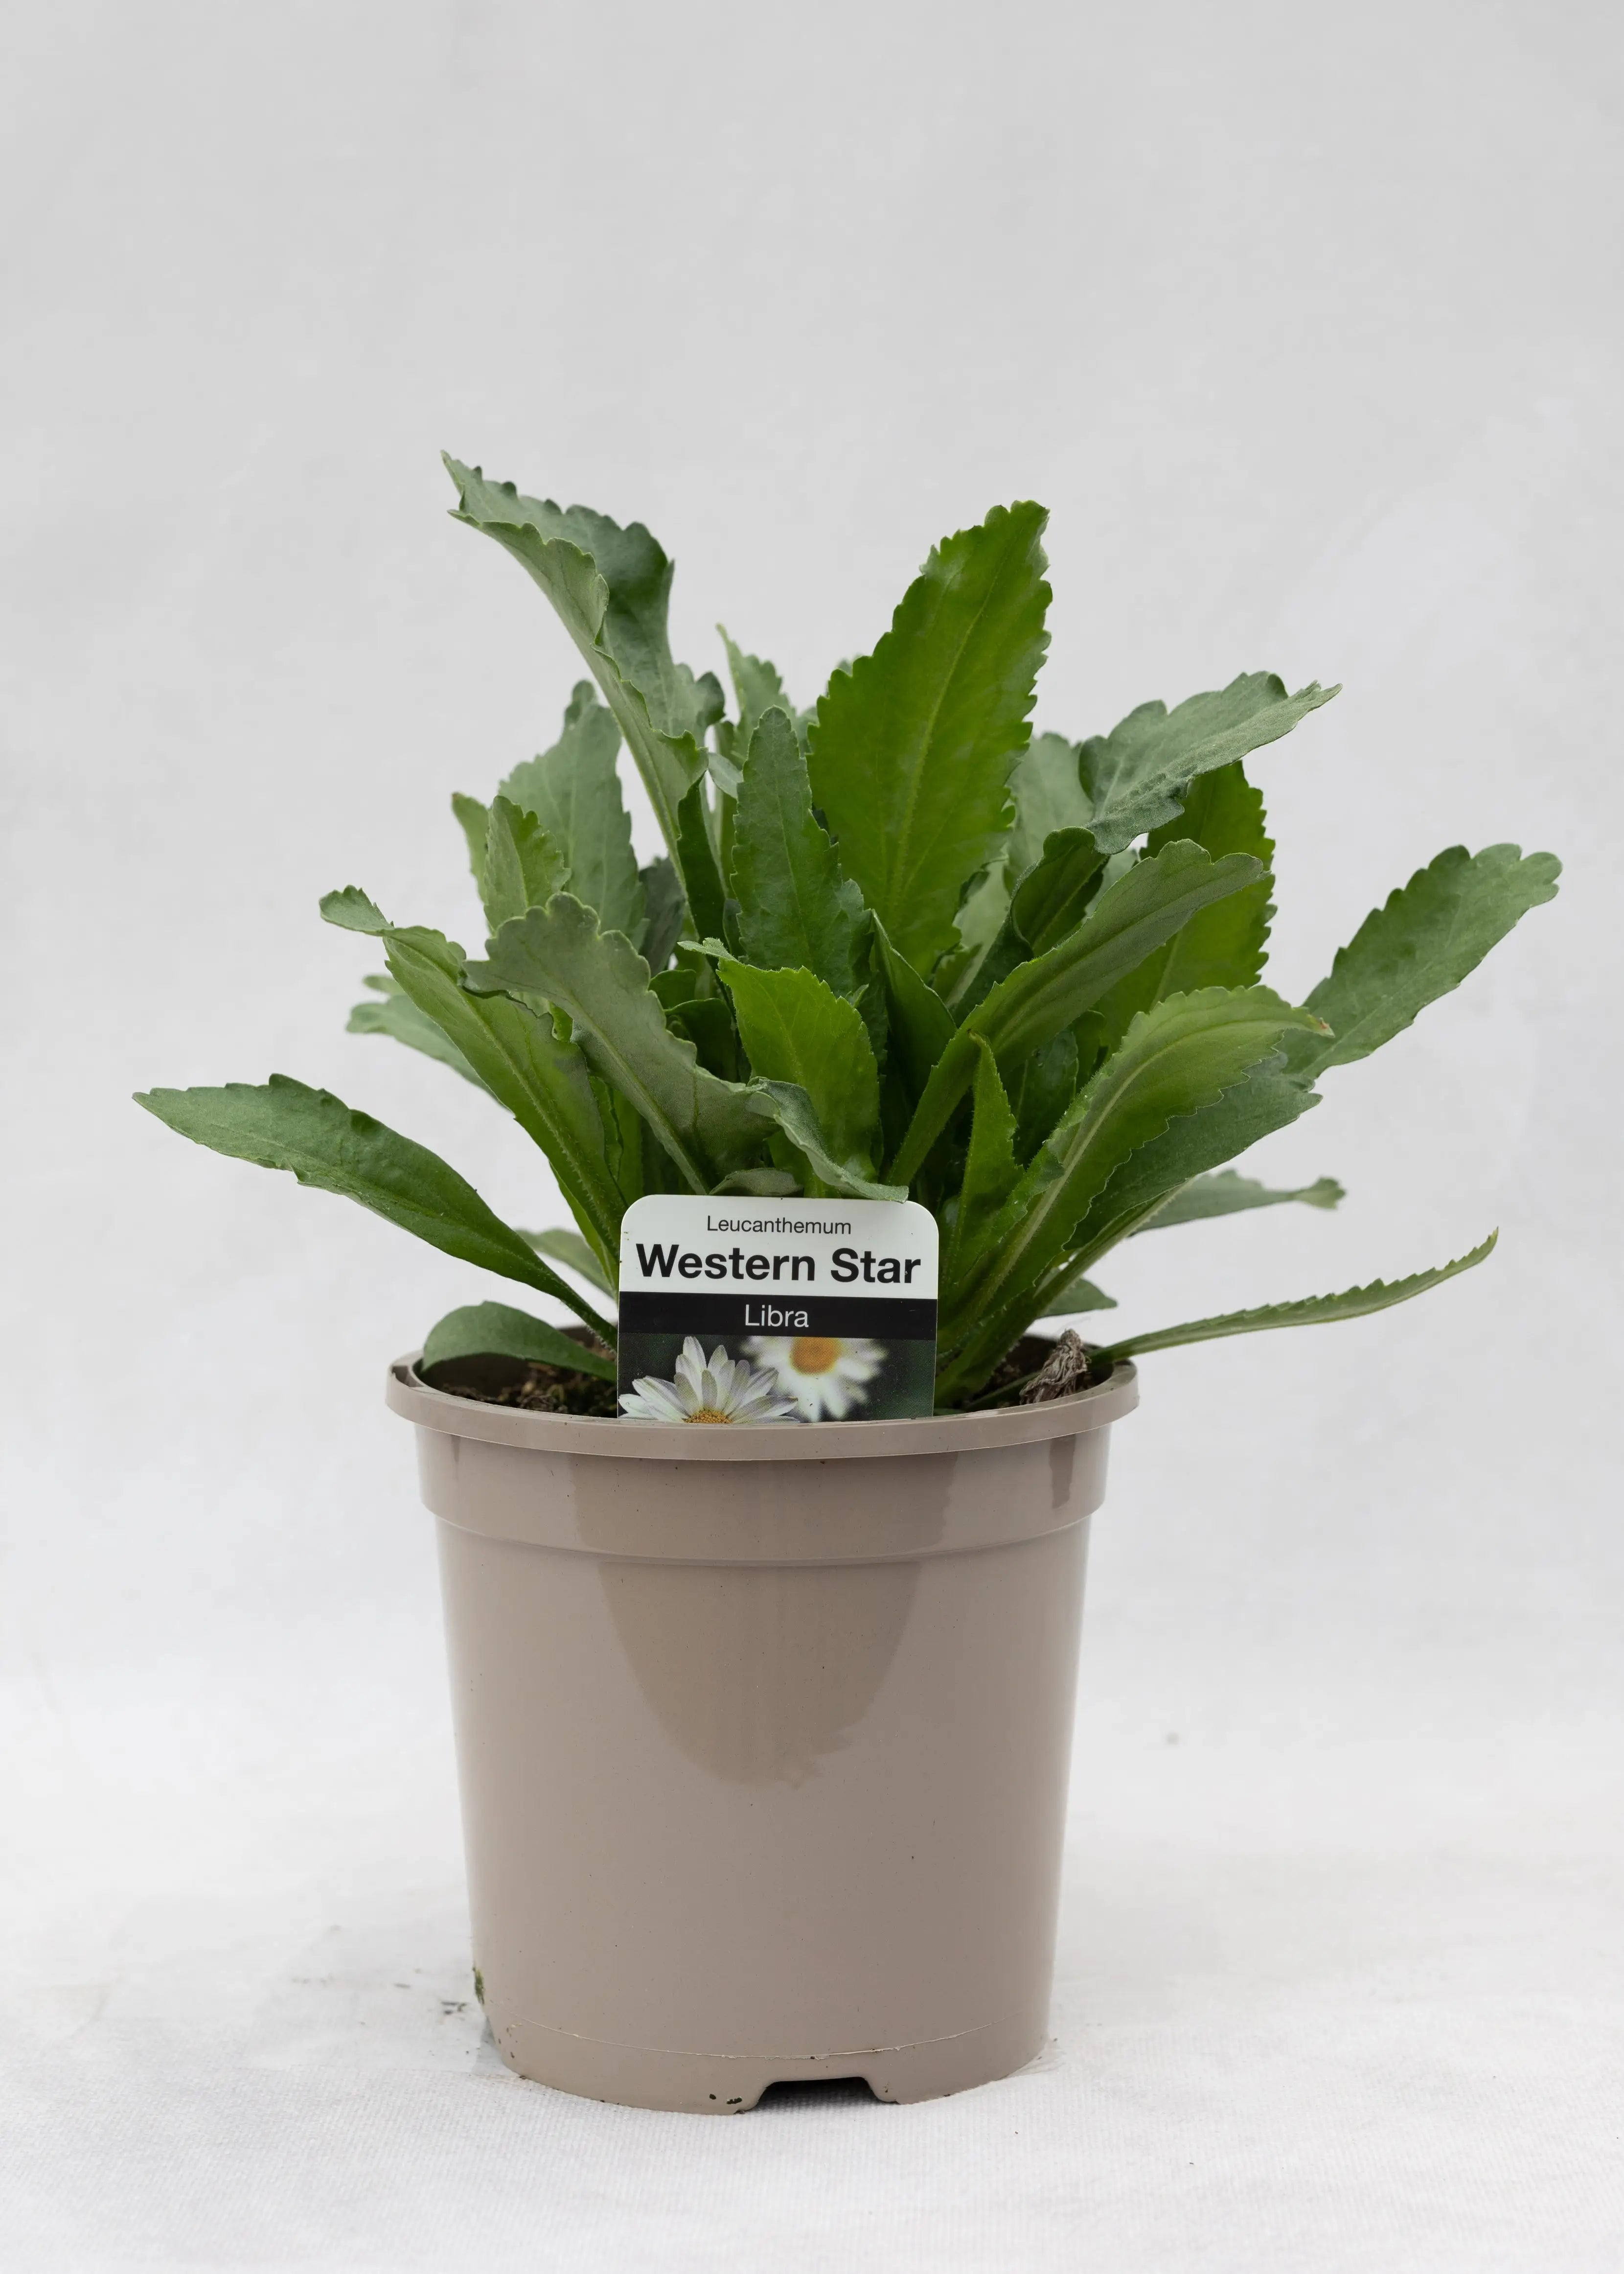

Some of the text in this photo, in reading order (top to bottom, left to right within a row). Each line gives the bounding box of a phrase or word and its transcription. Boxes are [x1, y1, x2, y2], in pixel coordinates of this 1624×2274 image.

[707, 1215, 851, 1235] Leucanthemum
[636, 1243, 921, 1284] Western Star
[745, 1304, 809, 1328] Libra
